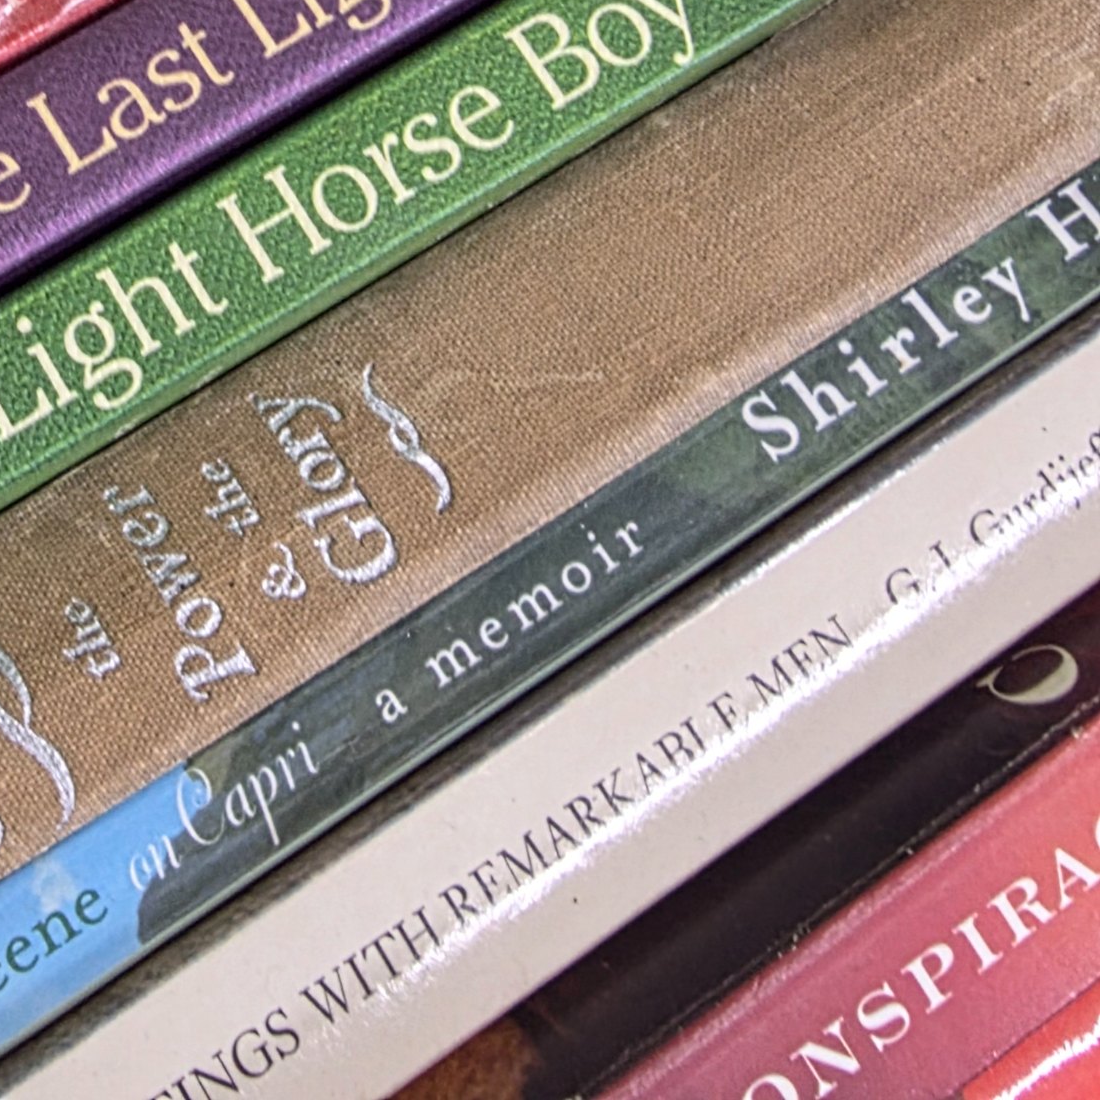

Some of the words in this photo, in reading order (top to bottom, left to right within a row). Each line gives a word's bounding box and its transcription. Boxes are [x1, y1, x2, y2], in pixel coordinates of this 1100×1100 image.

[27, 22, 234, 175] Last
[217, 84, 514, 282] Horse
[741, 257, 1031, 463] Shirley
[201, 458, 260, 538] the
[250, 394, 396, 585] Glory
[261, 542, 307, 599] &
[63, 597, 122, 678] the
[104, 484, 258, 700] Power
[375, 687, 408, 722] a
[425, 514, 646, 689] memoir
[128, 835, 181, 891] on
[176, 720, 320, 846] Capri
[149, 1007, 301, 1100] INGS
[298, 907, 443, 1024] WITH
[438, 690, 740, 927] REMARKABLE
[746, 614, 855, 707] MEN
[742, 813, 1100, 1100] NSPIRA
